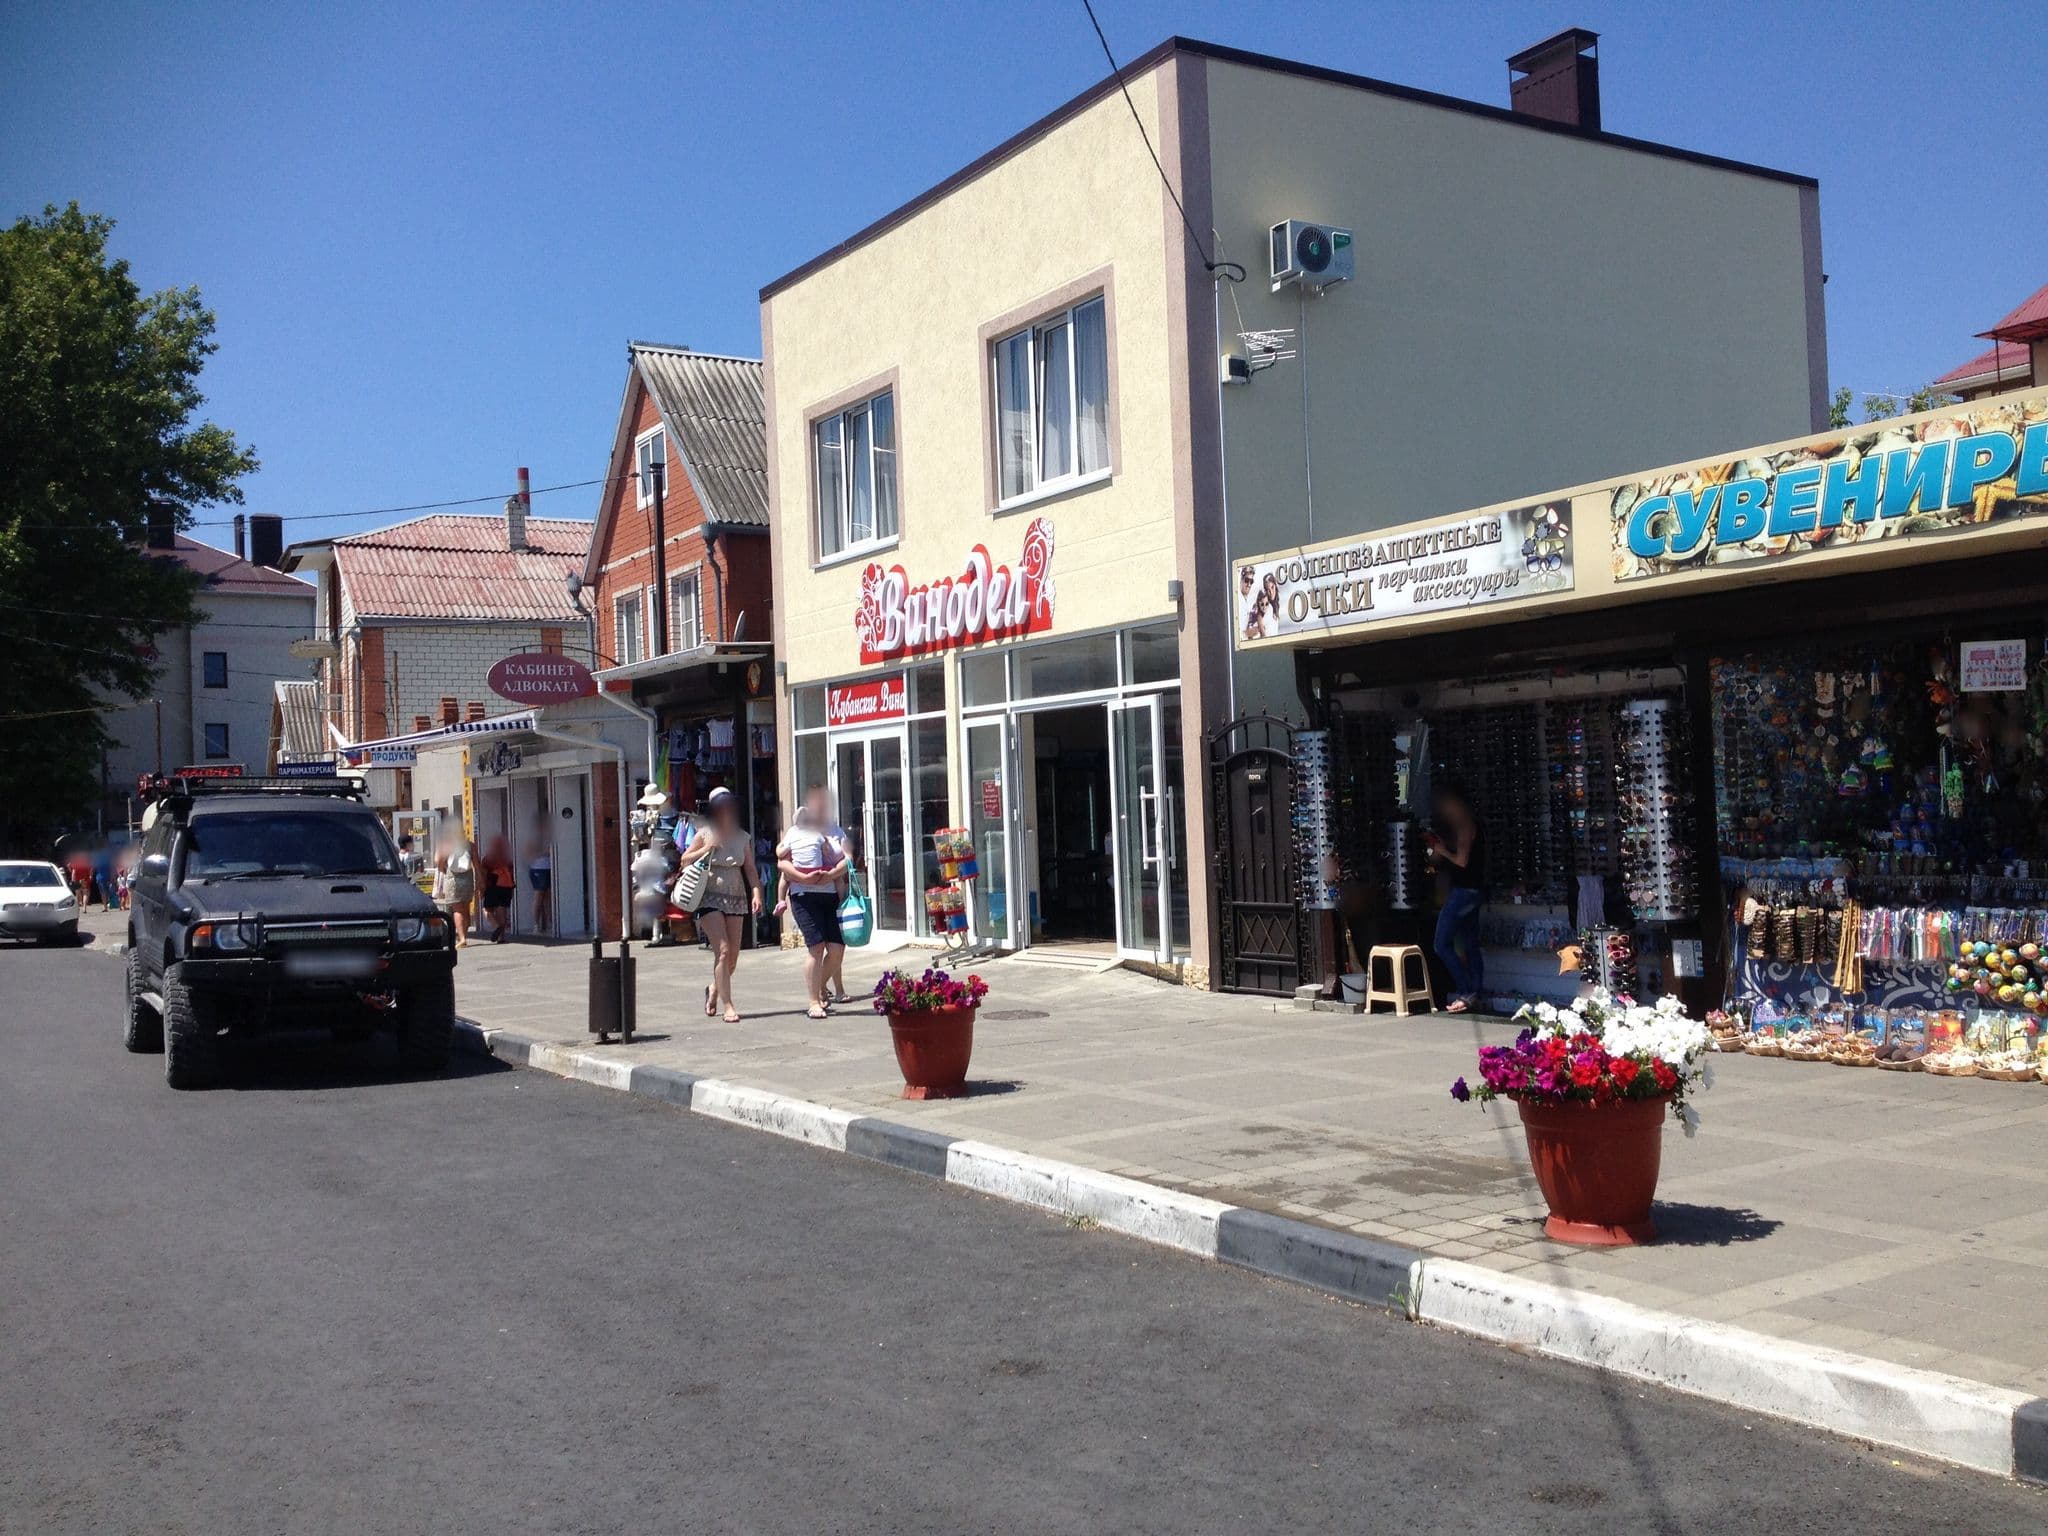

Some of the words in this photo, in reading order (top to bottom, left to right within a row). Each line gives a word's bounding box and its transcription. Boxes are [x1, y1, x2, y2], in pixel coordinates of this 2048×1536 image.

[1275, 518, 1502, 585] СОЛНЦЕЗАЩИТНЫЕ
[1378, 557, 1469, 592] перчатки
[1413, 568, 1520, 603] аксессуары
[876, 551, 1031, 651] Винодел
[1287, 576, 1374, 622] ОЧКИ
[502, 680, 579, 692] АДВОКАТА
[505, 664, 576, 676] КАБИНЕТ
[830, 688, 878, 724] Кубанские
[278, 765, 336, 775] ПАРИКМАХЕРСКАЯ
[371, 750, 416, 761] ПРОДУКТЫ
